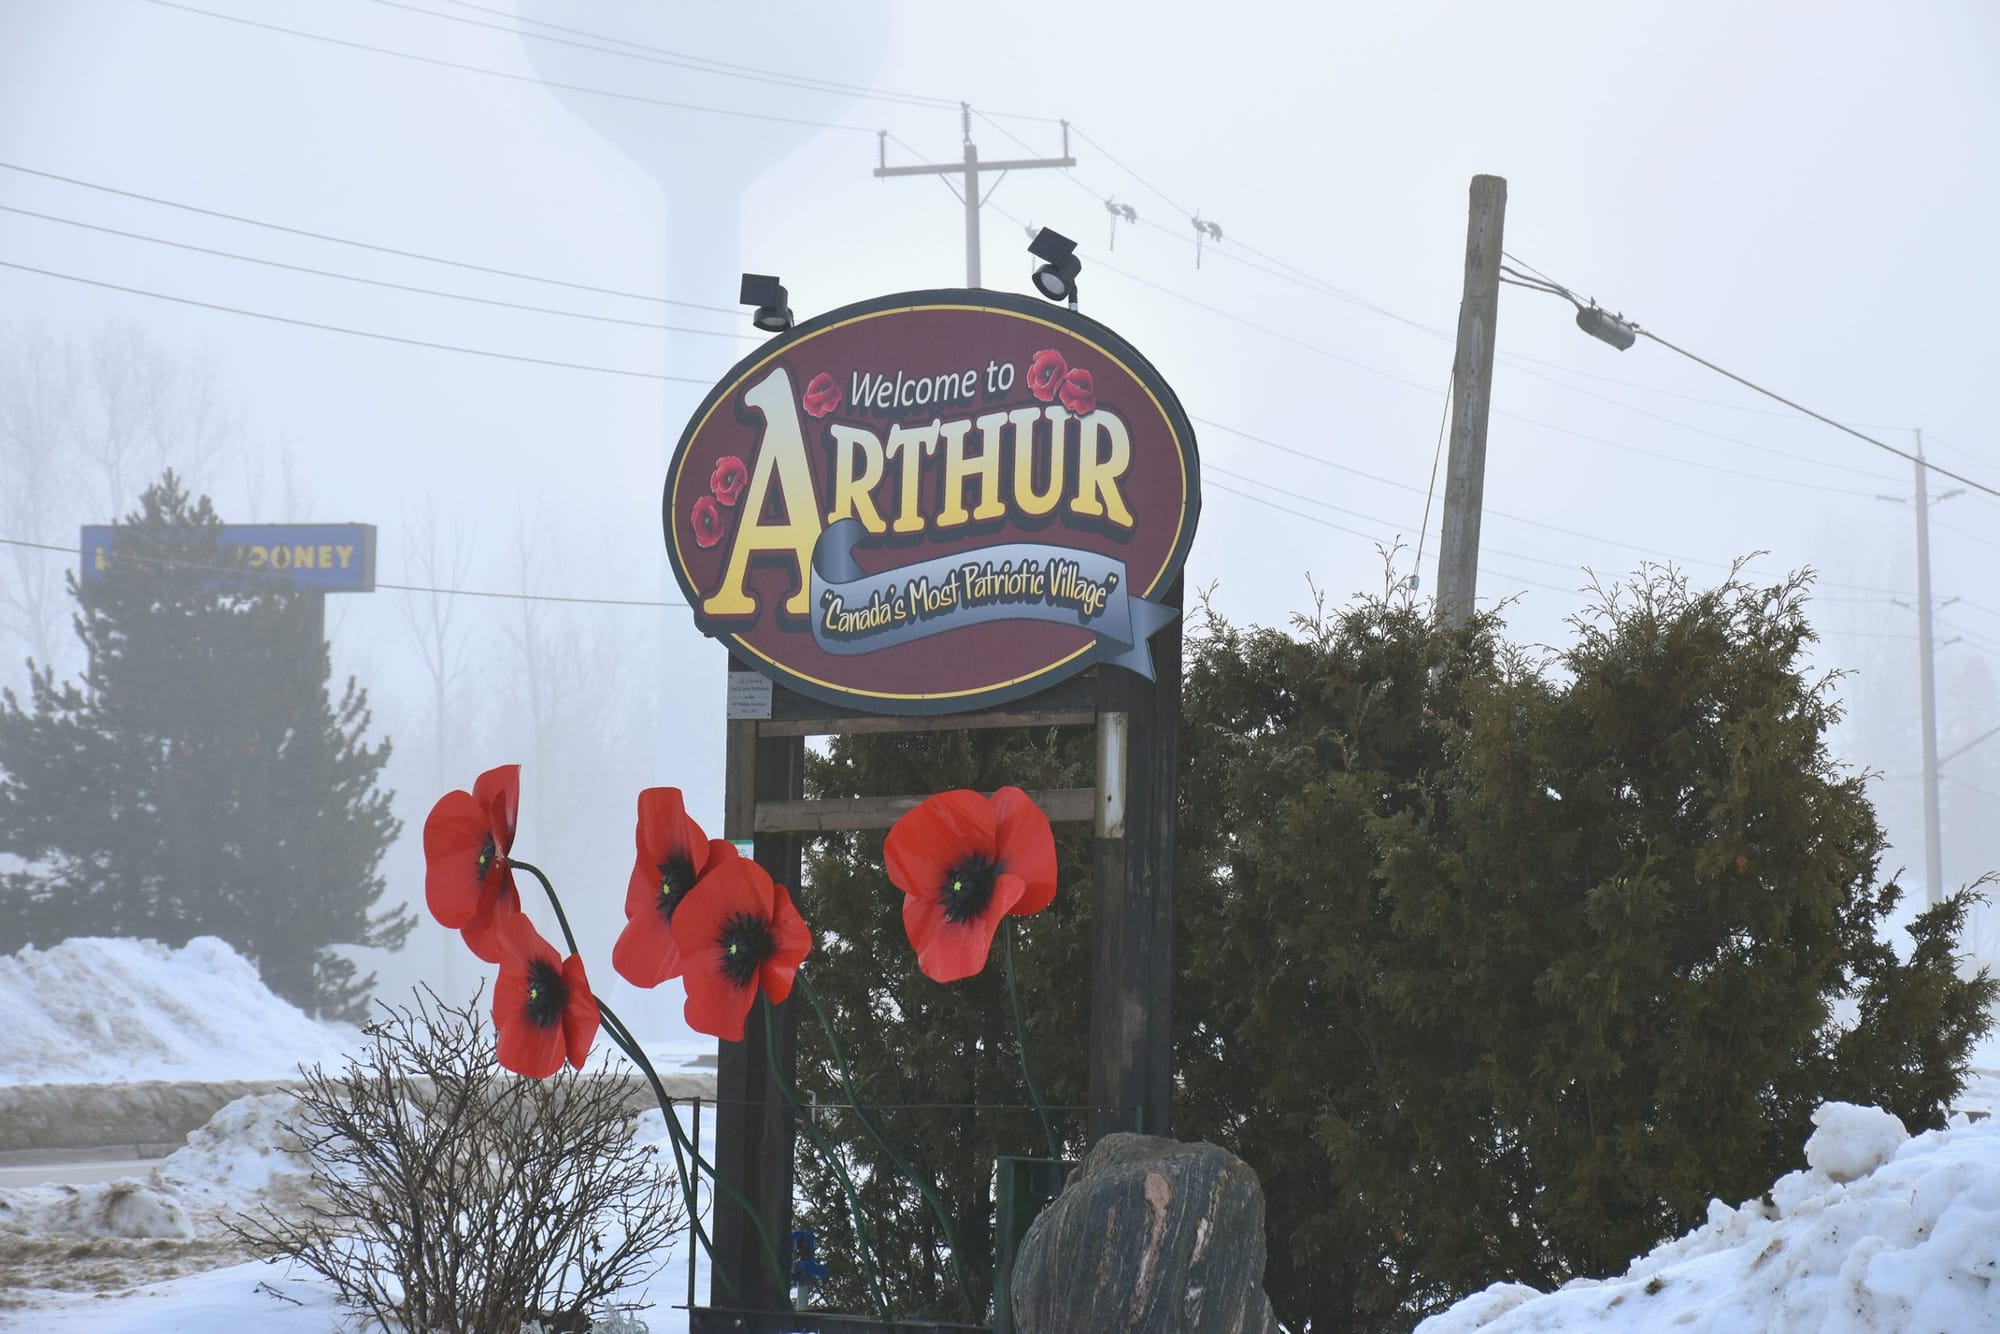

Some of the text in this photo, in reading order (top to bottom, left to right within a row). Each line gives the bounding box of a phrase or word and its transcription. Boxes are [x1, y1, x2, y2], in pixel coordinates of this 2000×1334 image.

[851, 360, 1015, 408] Welcome to
[703, 367, 1134, 615] ARTHUR
[236, 545, 353, 570] OONEY
[825, 560, 1118, 632] "Canada's Most Patriotic Village"
